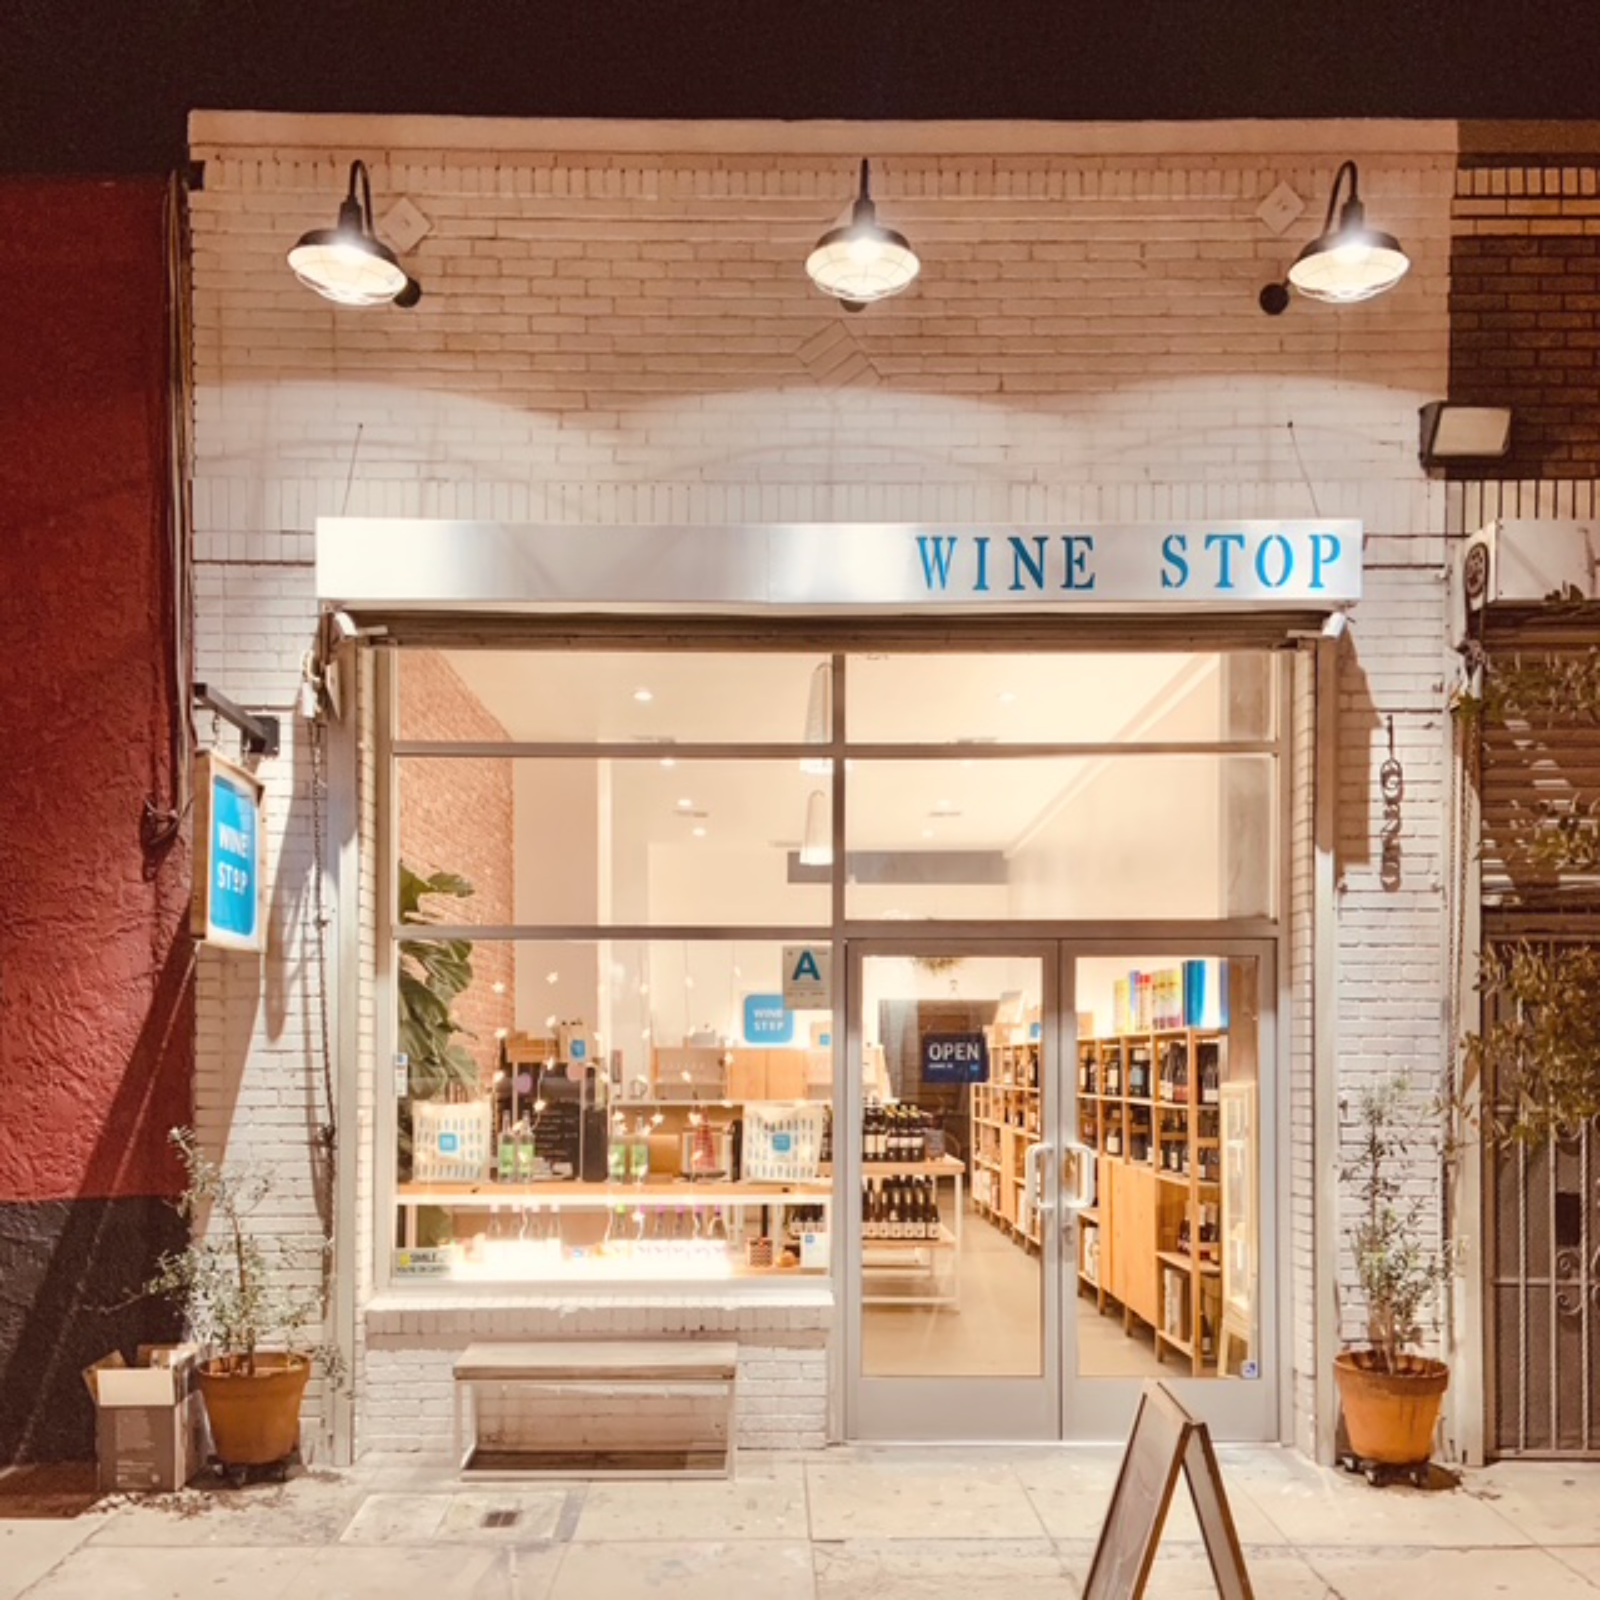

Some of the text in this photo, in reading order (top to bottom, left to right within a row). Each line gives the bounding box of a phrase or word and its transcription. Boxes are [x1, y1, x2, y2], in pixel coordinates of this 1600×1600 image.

[915, 534, 1341, 591] WINE STOP
[218, 822, 249, 858] WINE
[218, 861, 249, 895] STOP
[792, 949, 821, 981] A
[929, 1043, 979, 1061] OPEN
